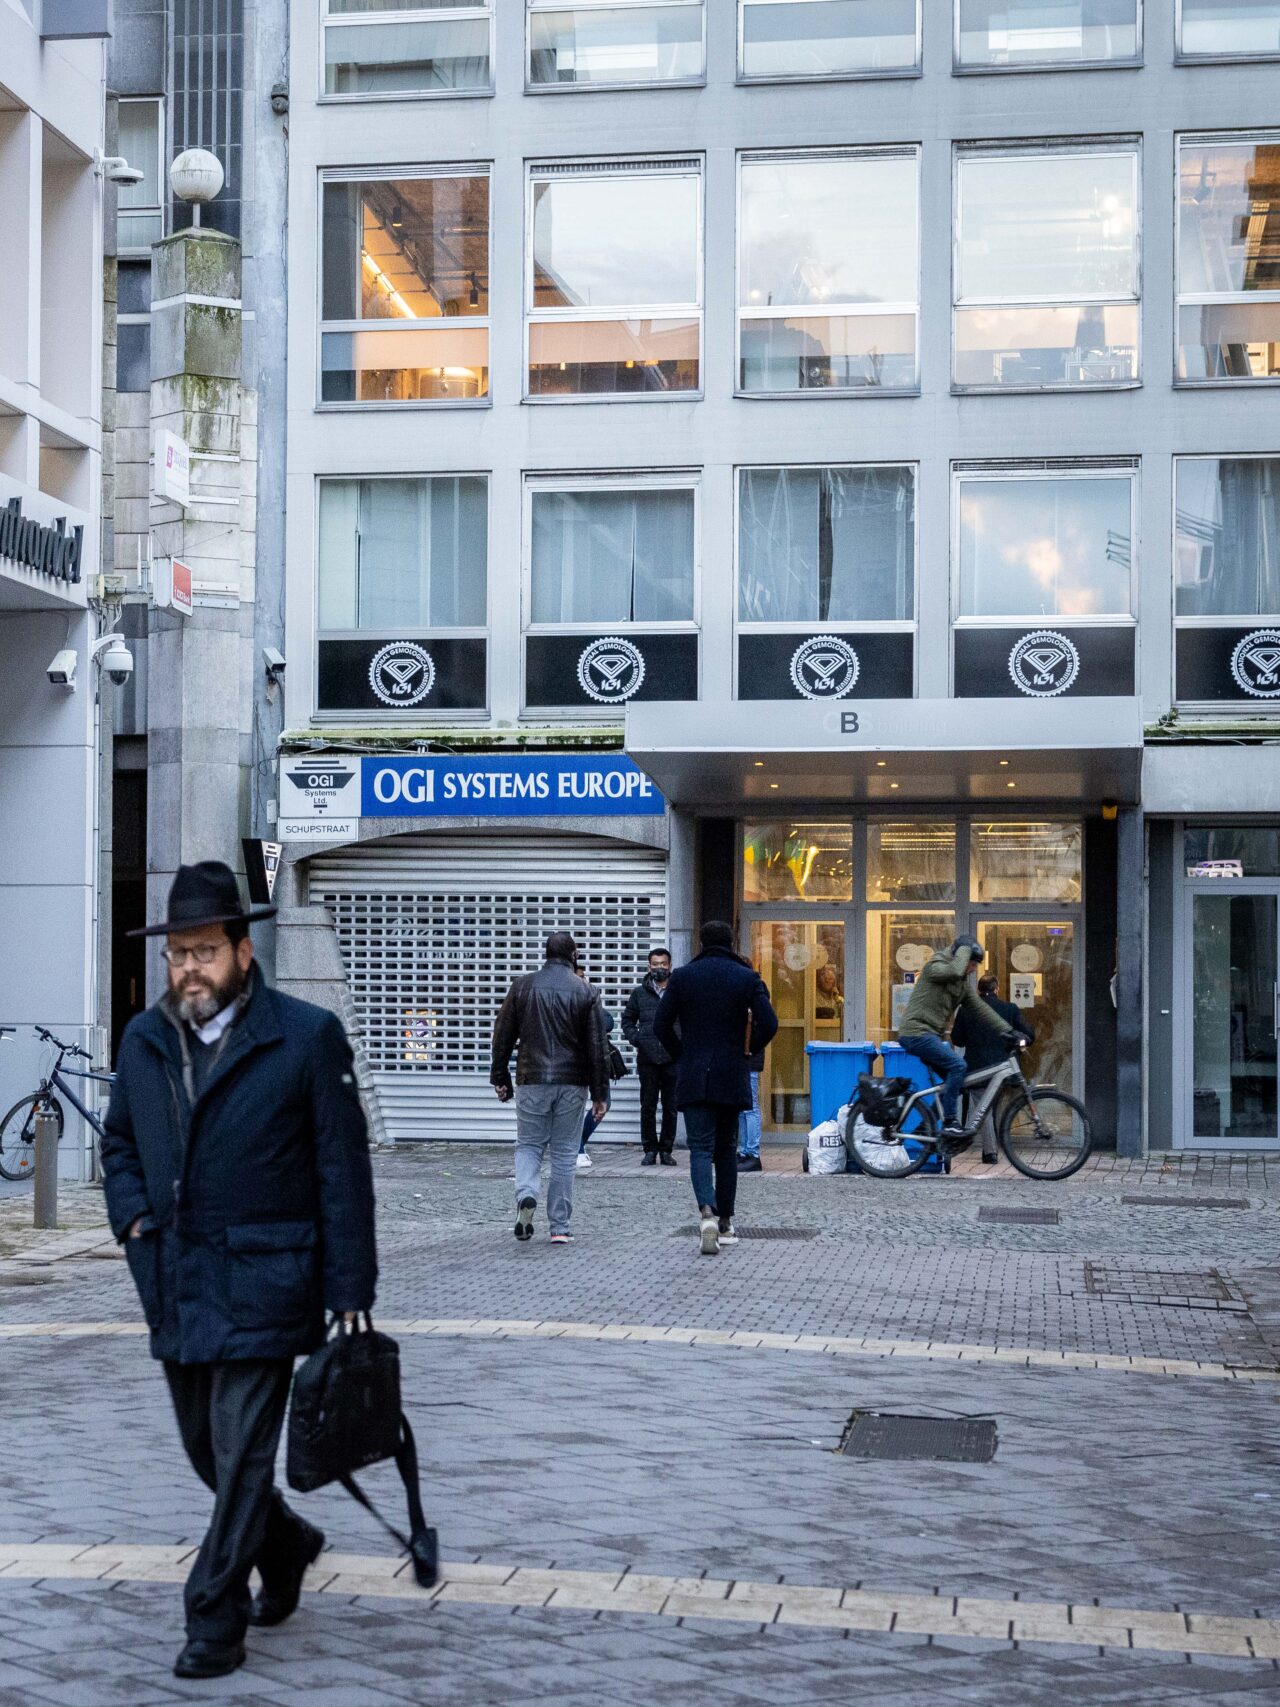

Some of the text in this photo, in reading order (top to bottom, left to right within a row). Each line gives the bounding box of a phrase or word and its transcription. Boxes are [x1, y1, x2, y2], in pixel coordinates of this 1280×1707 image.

[390, 648, 429, 671] GEMOLOGICAL
[599, 643, 638, 667] GEMOLOGICAL
[812, 642, 852, 666] GEMOLOGICAL
[1031, 637, 1072, 661] GEMOLOGICAL
[308, 775, 334, 787] OGI
[373, 768, 652, 804] OGI SYSTEMS EUROPE
[304, 789, 337, 798] Systems
[285, 825, 350, 834] SCHUPSTRAAT
